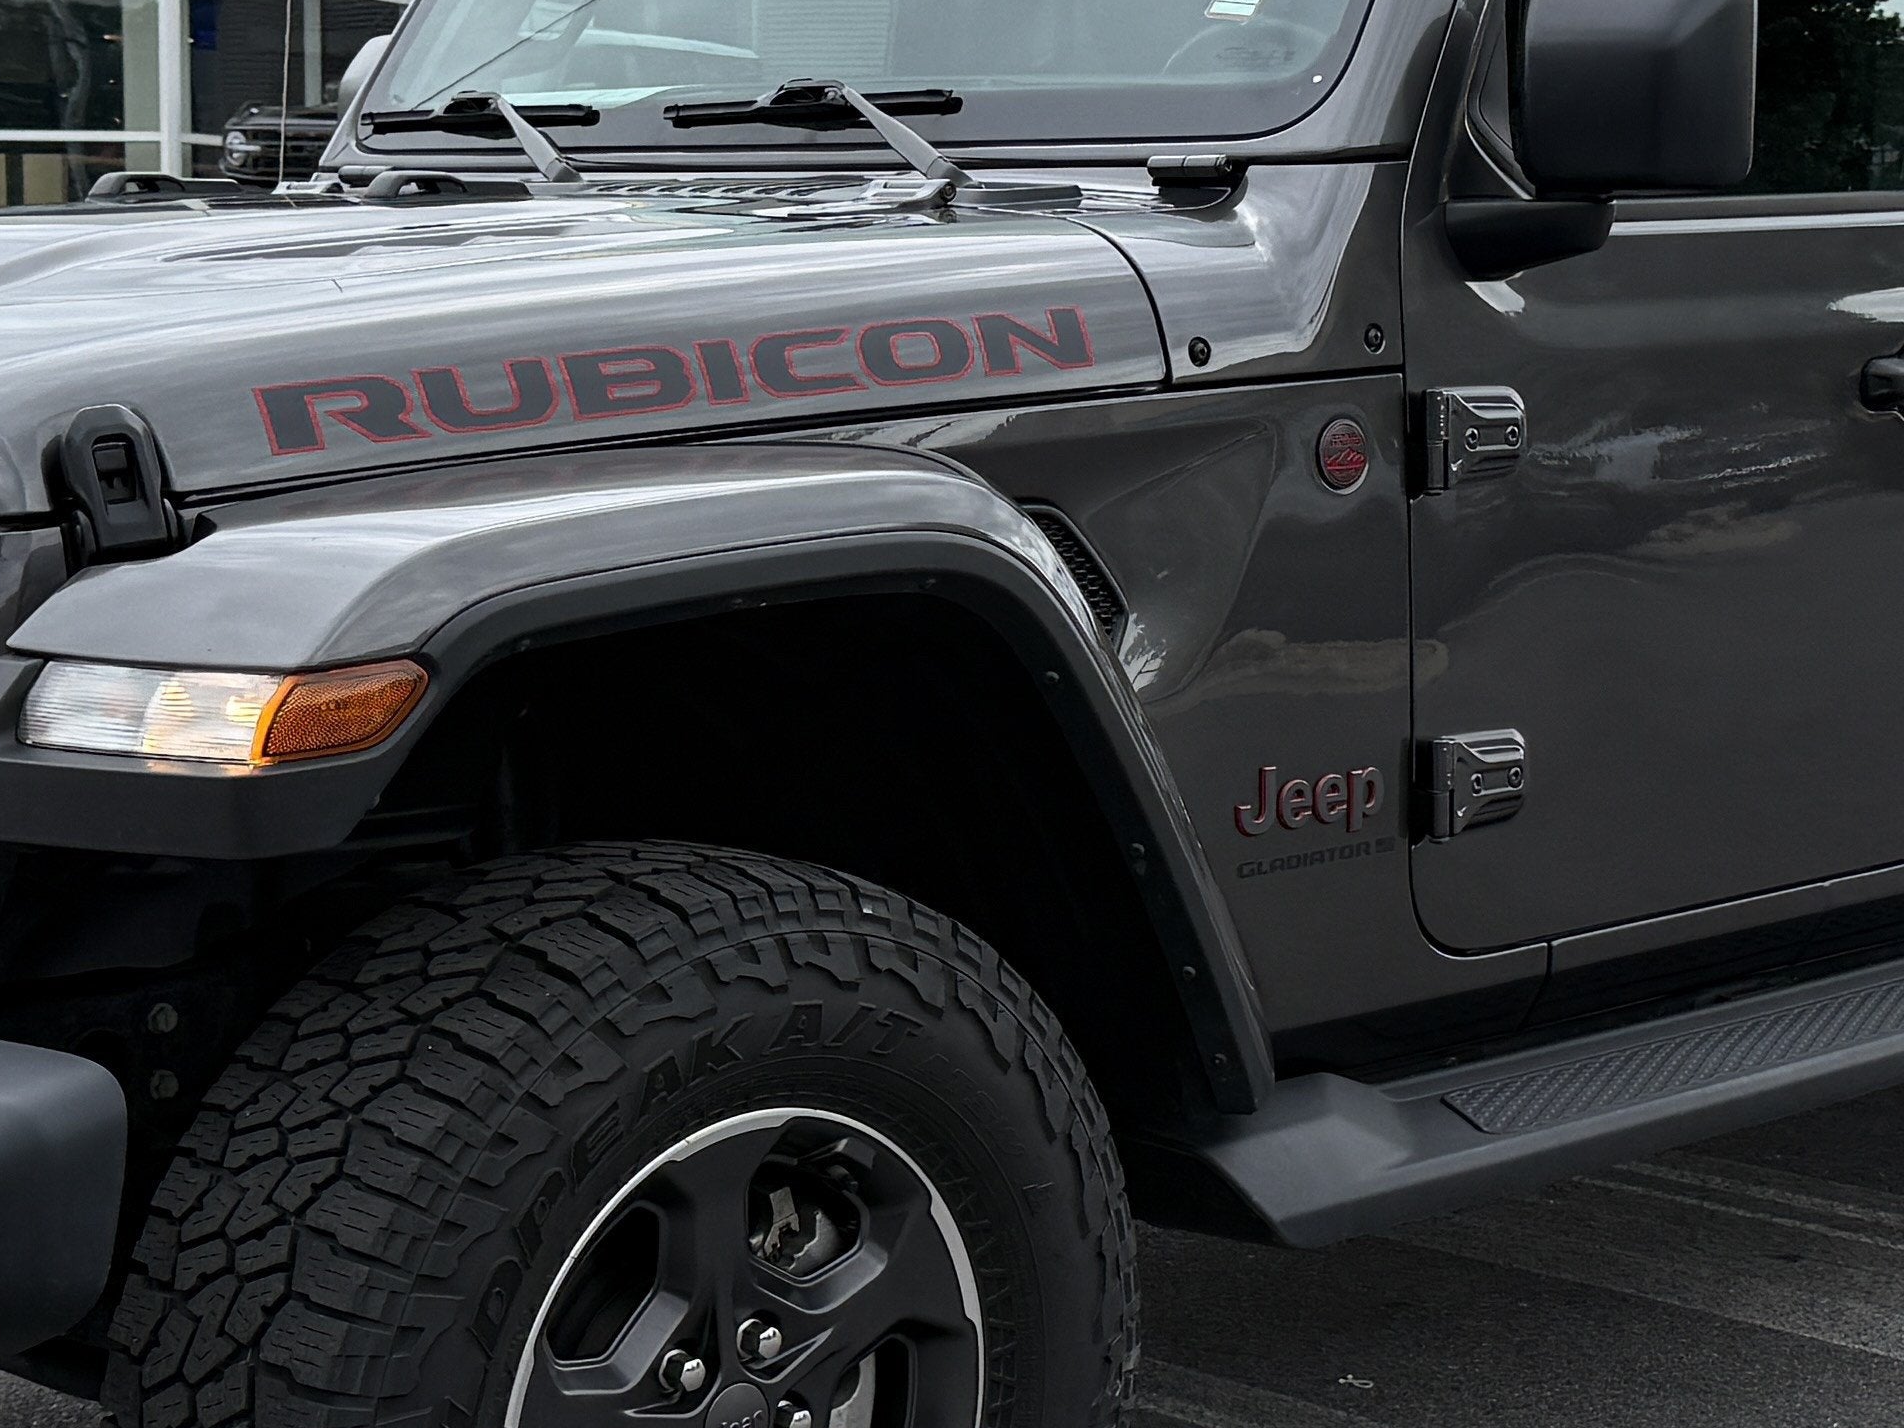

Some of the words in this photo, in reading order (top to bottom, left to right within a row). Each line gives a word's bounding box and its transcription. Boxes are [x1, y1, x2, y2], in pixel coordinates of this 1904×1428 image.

[253, 305, 1095, 456] RUBICON
[1234, 765, 1385, 837] Jeep
[1237, 840, 1371, 879] GLADIATOR
[770, 999, 927, 1056] A/T
